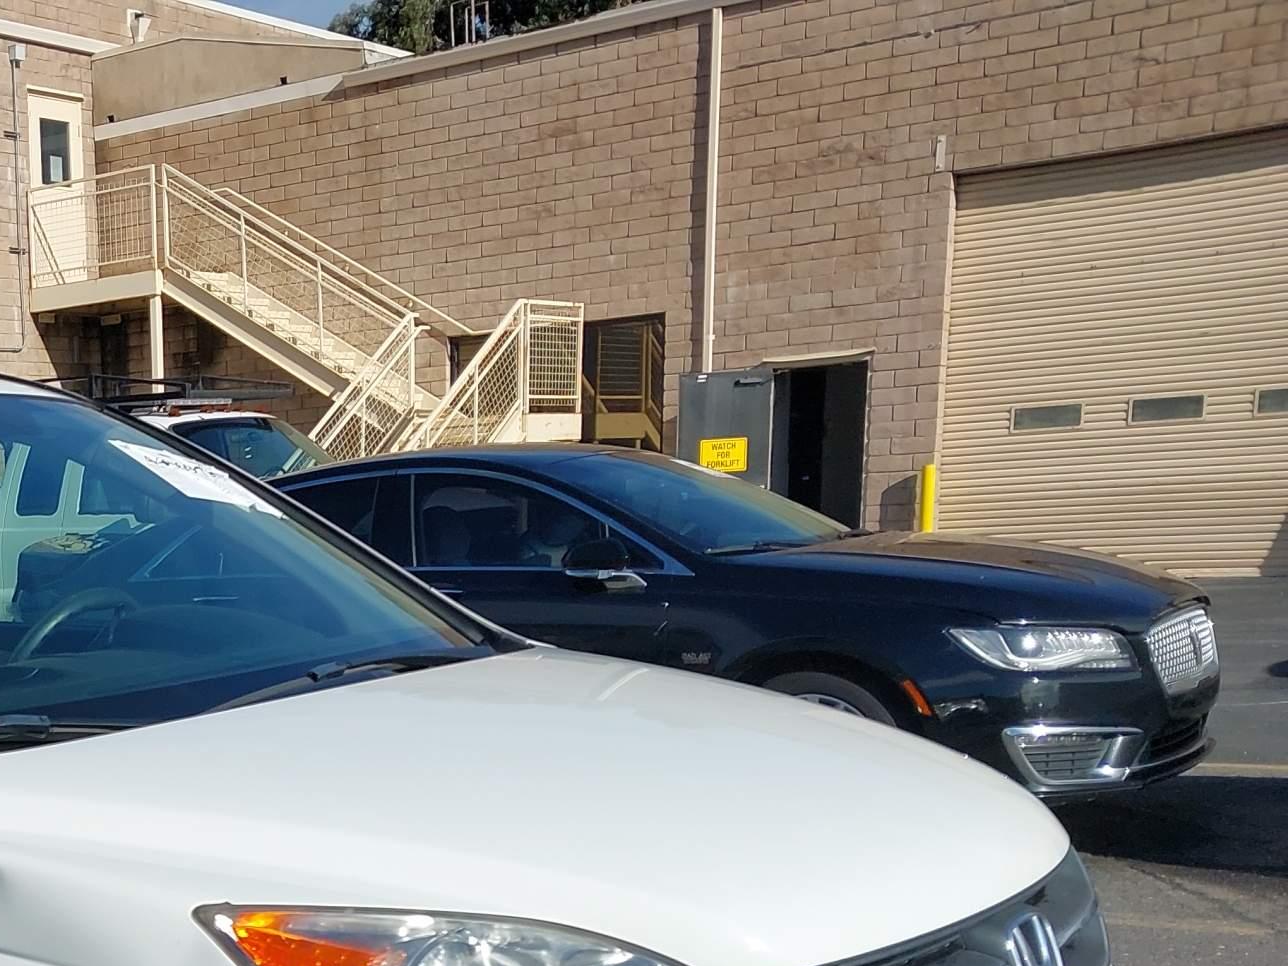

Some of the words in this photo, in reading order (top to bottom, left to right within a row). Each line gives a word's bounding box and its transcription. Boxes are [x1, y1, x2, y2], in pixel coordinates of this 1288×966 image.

[711, 442, 737, 451] WATCH
[716, 451, 730, 459] FOR
[706, 459, 740, 468] FORKLIFT
